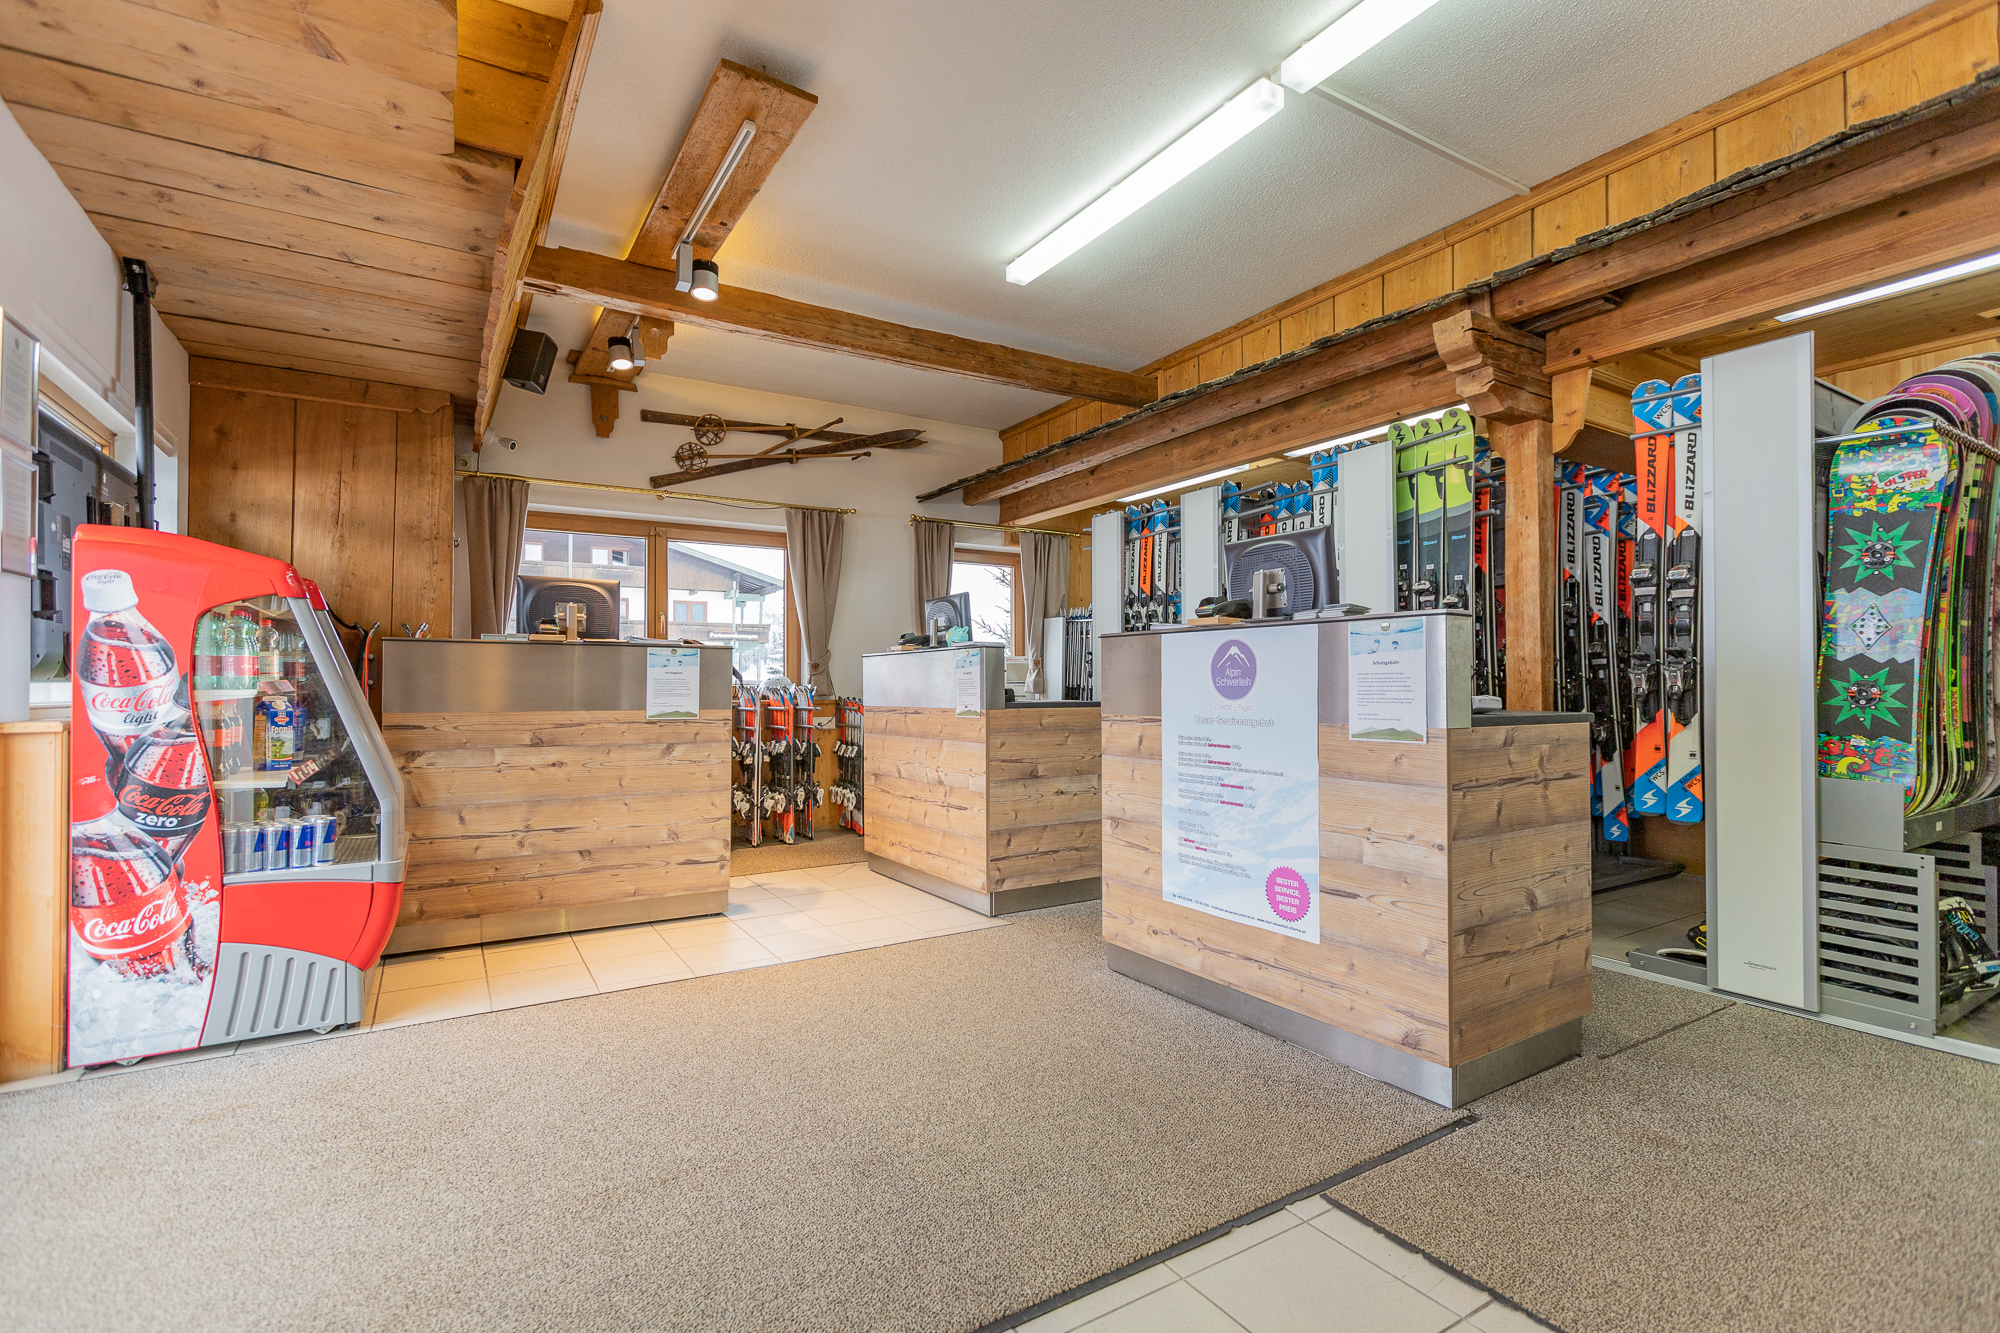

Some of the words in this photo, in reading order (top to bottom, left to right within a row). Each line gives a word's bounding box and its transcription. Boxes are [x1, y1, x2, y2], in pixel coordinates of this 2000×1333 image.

[1654, 403, 1672, 420] WCS
[1646, 436, 1657, 514] BLIZZARD
[1684, 432, 1697, 511] BLIZZARD
[1910, 478, 1931, 488] 120
[1567, 492, 1576, 564] BLIZZARD
[1592, 536, 1604, 607] BLIZZARD
[1225, 667, 1241, 678] Alpin
[1215, 677, 1251, 687] Schiverleih
[91, 677, 175, 713] Coca-Cola
[123, 711, 160, 727] light
[1194, 715, 1215, 725] Unser
[1216, 716, 1275, 729] Serviceangebot
[1650, 769, 1666, 781] WCS
[1679, 769, 1698, 785] RACING
[1685, 777, 1701, 790] WCS
[119, 784, 211, 817] Coca-Cola
[134, 812, 182, 828] zero
[1275, 877, 1299, 888] BESTER
[1274, 885, 1301, 898] SERVICE,
[1276, 895, 1300, 906] BESTER
[84, 886, 181, 943] Coca-Cola
[1279, 904, 1298, 914] PREIS
